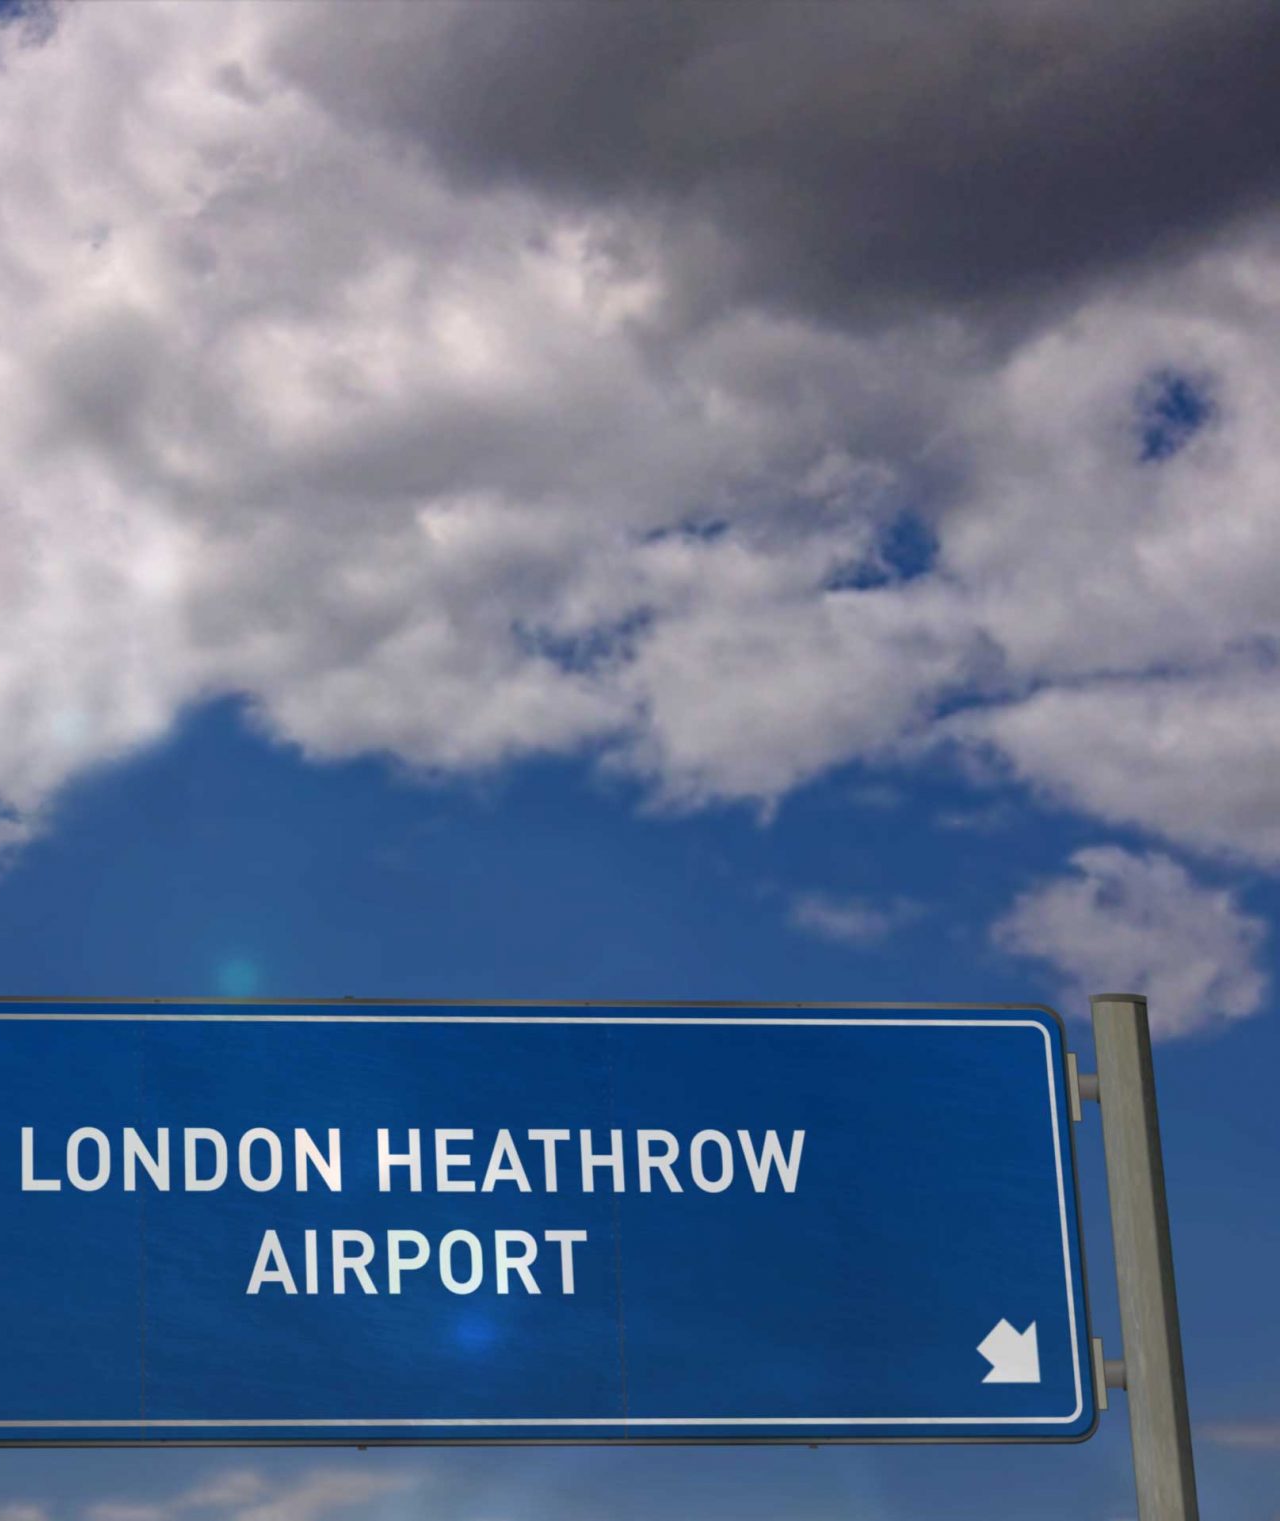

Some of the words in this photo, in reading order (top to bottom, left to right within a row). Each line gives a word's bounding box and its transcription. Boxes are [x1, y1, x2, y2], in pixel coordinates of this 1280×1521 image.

[21, 1127, 342, 1192] LONDON
[377, 1128, 805, 1193] HEATHROW
[246, 1229, 587, 1295] AIRPORT
